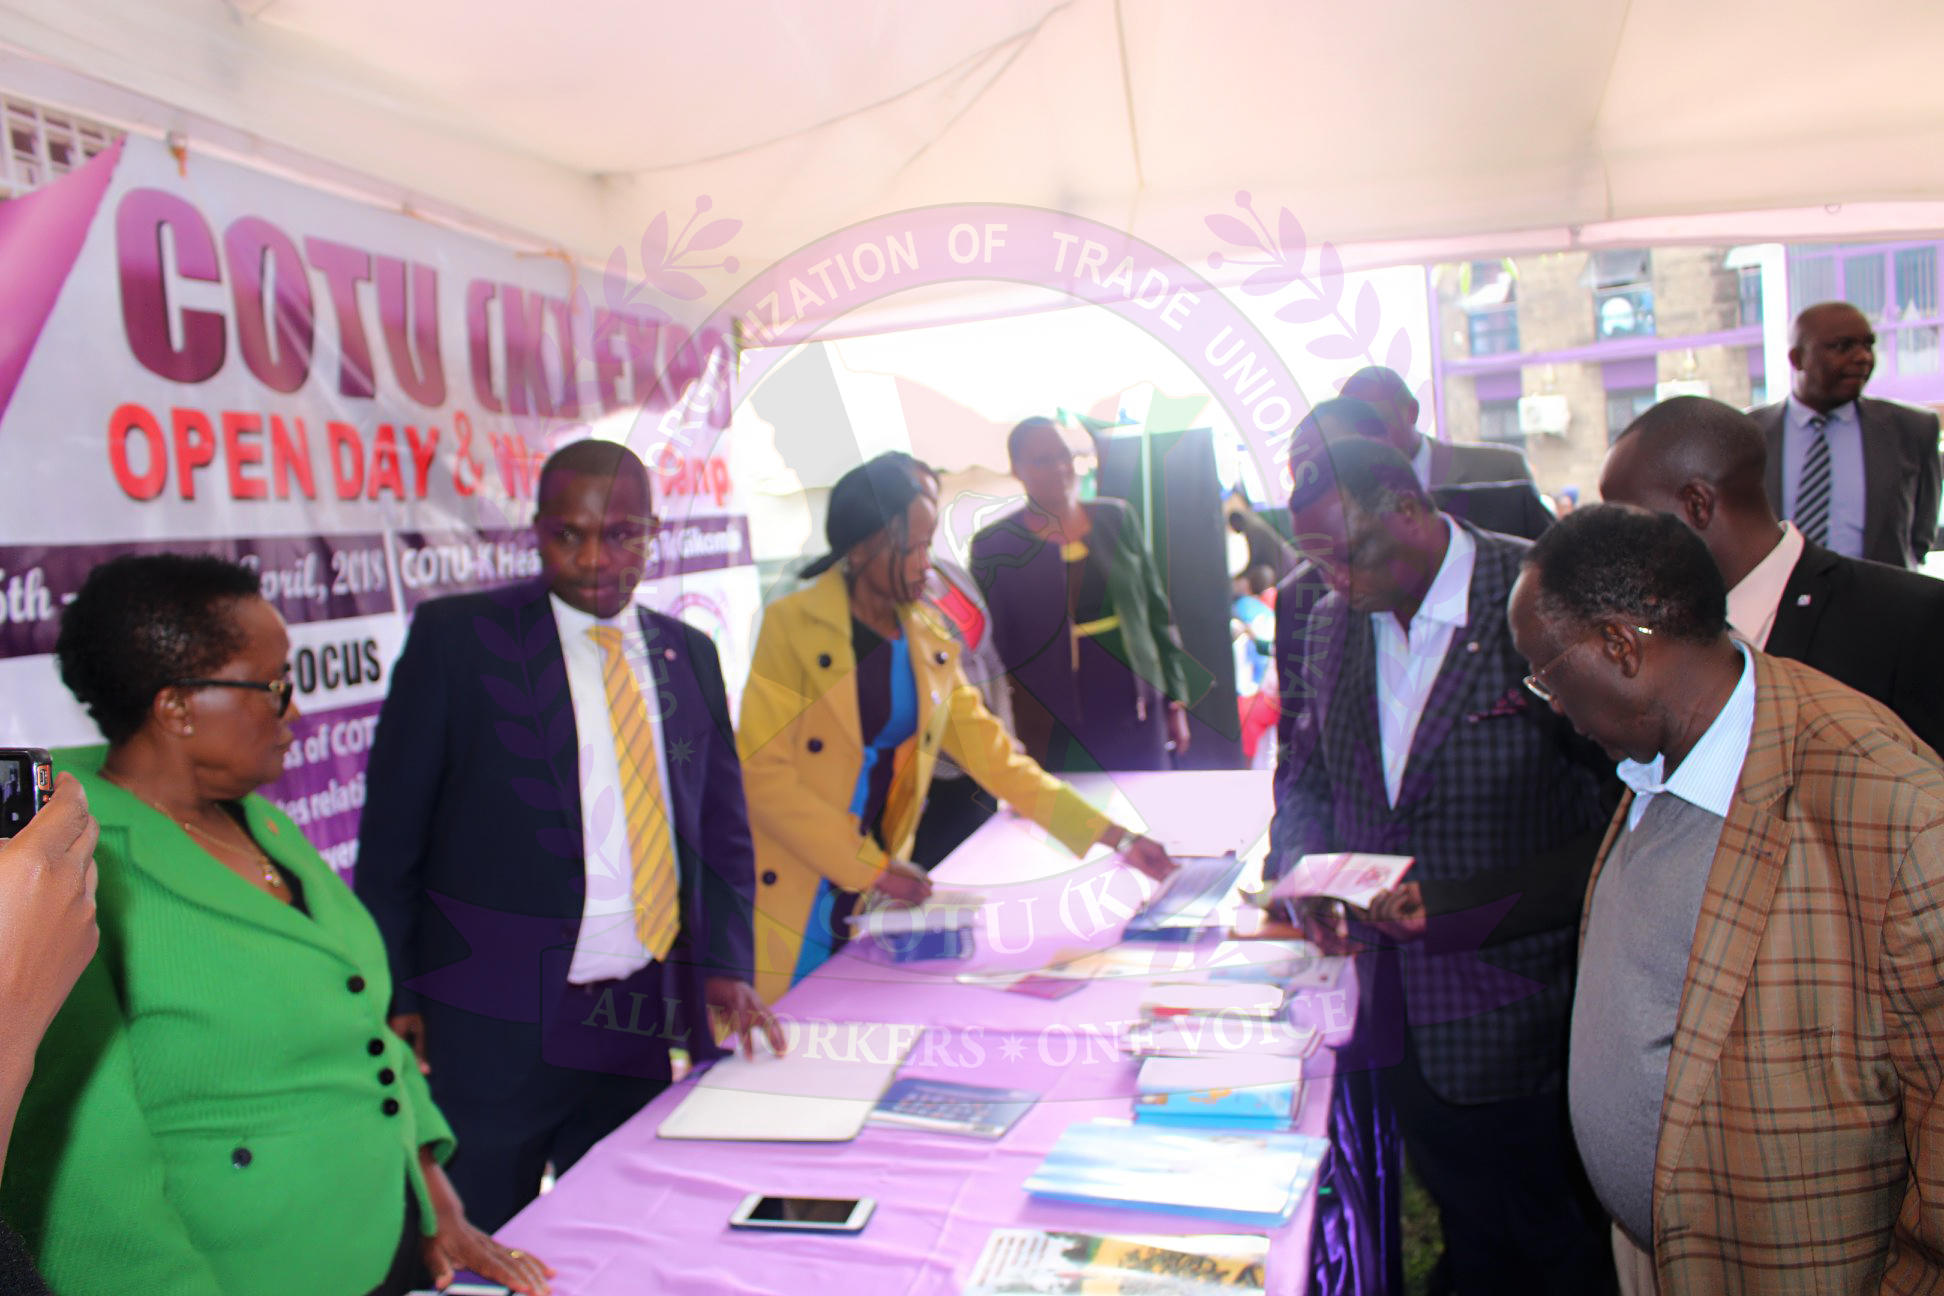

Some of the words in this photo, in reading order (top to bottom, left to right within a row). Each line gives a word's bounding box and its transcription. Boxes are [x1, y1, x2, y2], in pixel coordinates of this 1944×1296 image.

[115, 187, 448, 409] COTU
[108, 402, 315, 502] OPEN
[327, 418, 440, 501] DAY
[453, 409, 484, 498] &
[401, 543, 497, 589] COTU-K
[285, 638, 381, 694] OCUS
